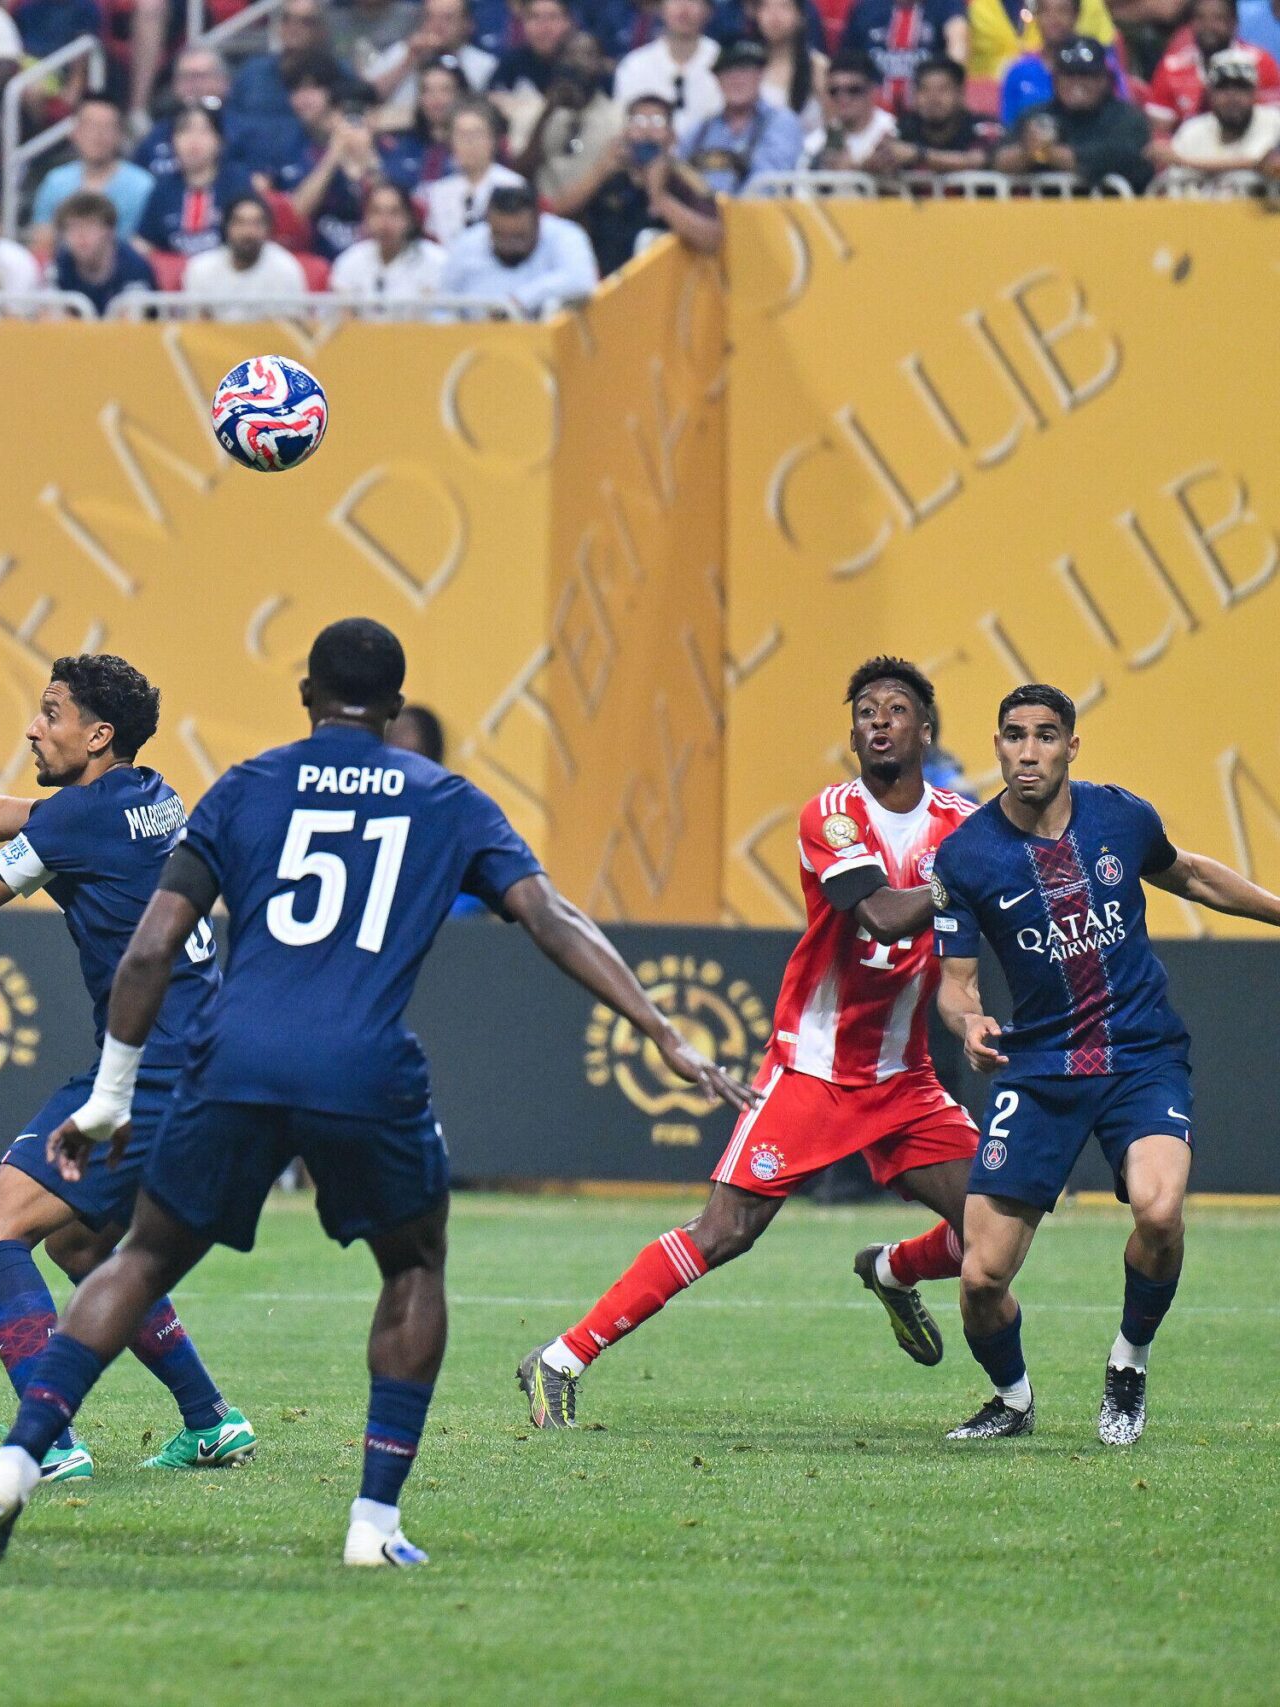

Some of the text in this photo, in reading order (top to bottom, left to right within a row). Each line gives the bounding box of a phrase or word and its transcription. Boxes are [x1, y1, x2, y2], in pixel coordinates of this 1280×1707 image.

[764, 266, 1123, 583] CLUB
[296, 764, 406, 797] PACHO
[265, 808, 412, 954] 51
[1016, 899, 1123, 954] QATAR
[1048, 923, 1126, 963] AIRWAYS
[988, 1090, 1020, 1139] 2
